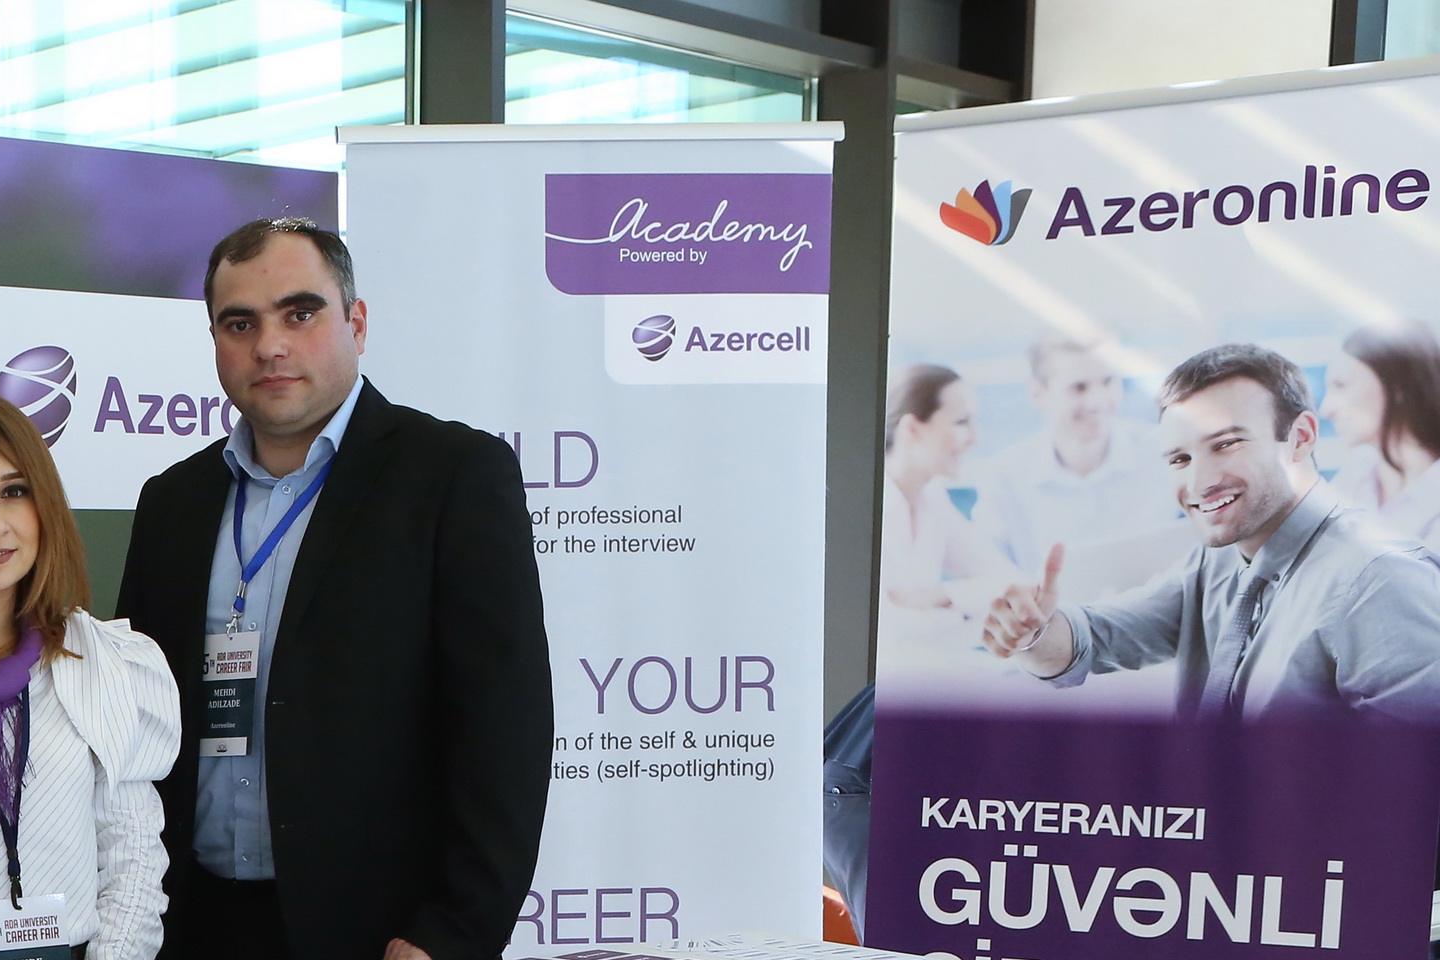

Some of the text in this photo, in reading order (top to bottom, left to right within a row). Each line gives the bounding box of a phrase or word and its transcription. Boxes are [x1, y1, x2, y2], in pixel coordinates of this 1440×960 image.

[1045, 165, 1430, 240] Azeronline
[619, 248, 708, 265] Powered by
[684, 326, 811, 352] Azercell
[531, 505, 682, 530] of professional
[564, 535, 596, 553] the
[603, 534, 696, 553] interview
[214, 688, 236, 697] MEHDI
[578, 655, 776, 715] YOUR
[575, 732, 594, 750] of
[600, 731, 632, 750] the
[639, 730, 676, 749] self
[682, 730, 698, 749] &
[705, 731, 776, 752] unique
[597, 757, 775, 783] (self-spotlighting)
[921, 797, 1207, 840] KARYERANIZI
[918, 844, 1344, 950] GÜVƏNLİ
[4, 919, 19, 930] ADA
[20, 915, 58, 928] UNIVERSITY
[6, 926, 60, 943] CAREER FAIR
